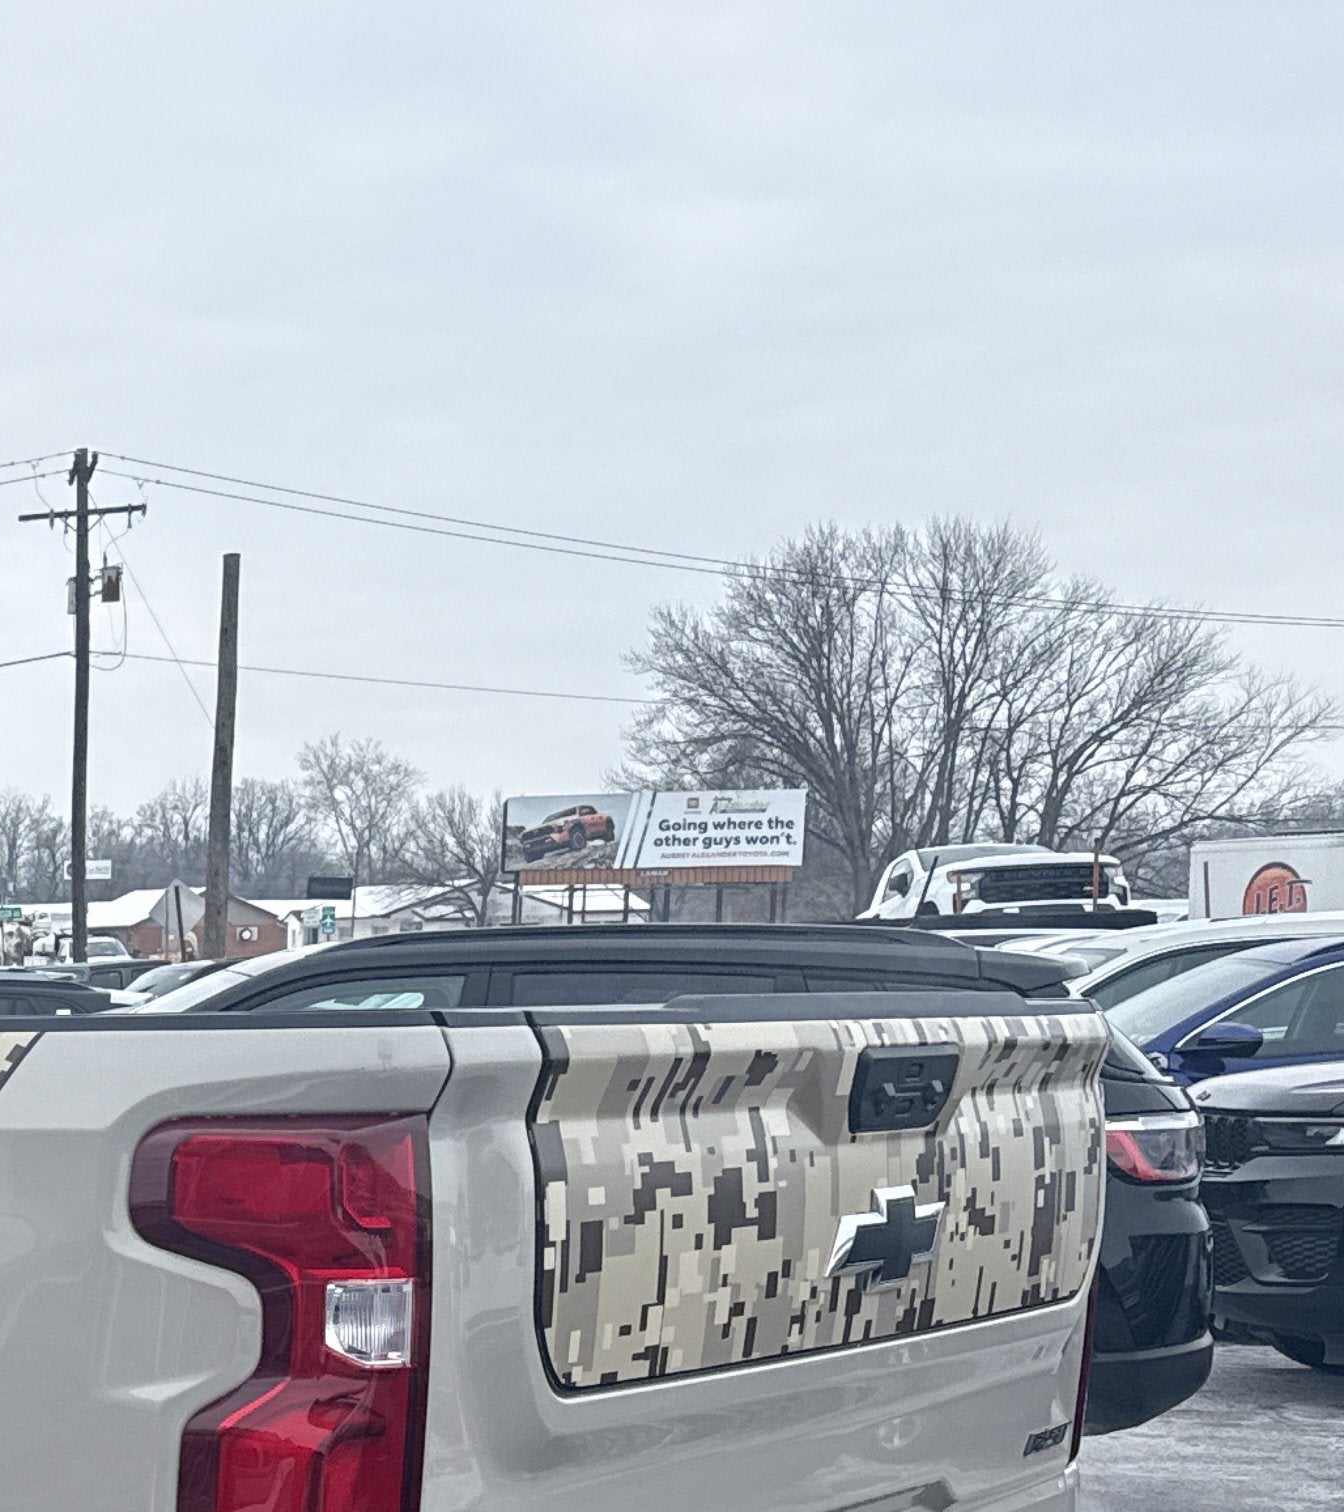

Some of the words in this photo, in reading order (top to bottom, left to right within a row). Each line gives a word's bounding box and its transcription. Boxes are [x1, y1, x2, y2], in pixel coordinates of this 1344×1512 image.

[658, 818, 708, 834] Going
[712, 817, 763, 830] where
[767, 816, 795, 830] the
[653, 834, 699, 847] other
[702, 834, 741, 849] guys
[745, 831, 797, 845] won't.
